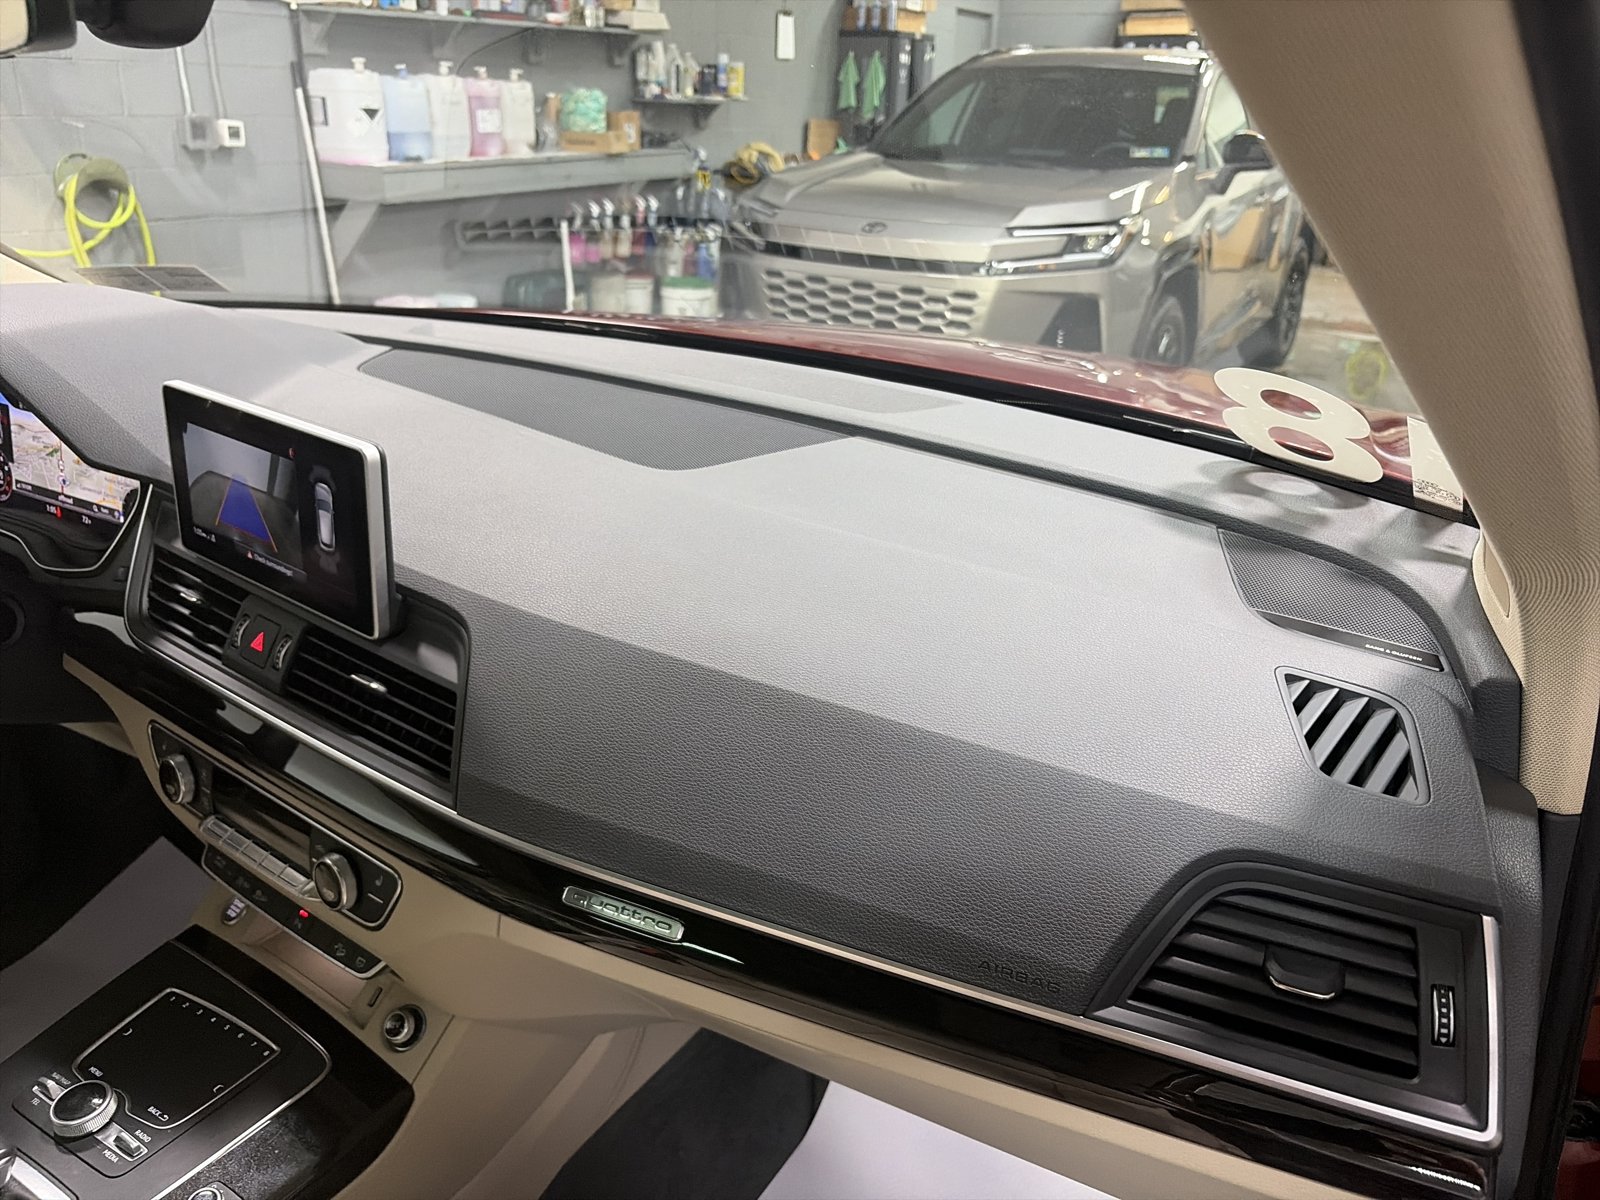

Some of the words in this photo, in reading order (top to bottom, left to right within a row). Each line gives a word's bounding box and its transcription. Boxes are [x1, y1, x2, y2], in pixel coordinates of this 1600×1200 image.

[573, 892, 672, 934] quattro
[978, 959, 1061, 994] AIRBAG
[88, 1066, 104, 1077] MENU
[31, 1097, 41, 1106] TEL
[147, 1105, 162, 1119] BACK
[134, 1129, 152, 1143] RADIO
[102, 1149, 120, 1163] MEDIA
